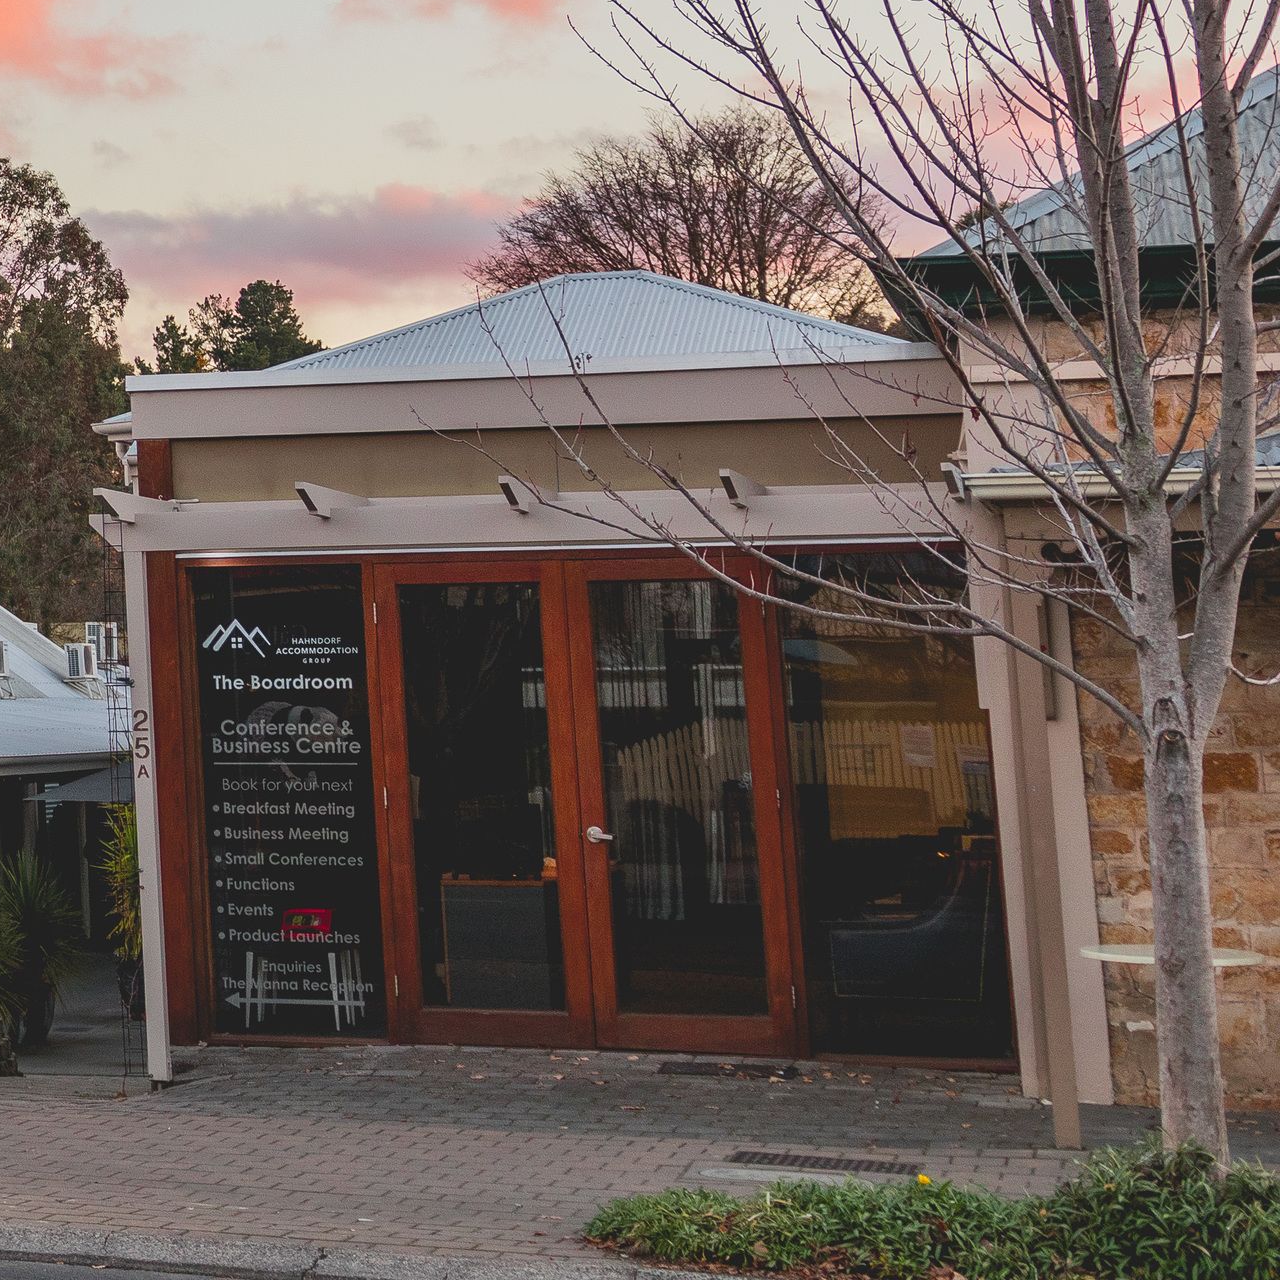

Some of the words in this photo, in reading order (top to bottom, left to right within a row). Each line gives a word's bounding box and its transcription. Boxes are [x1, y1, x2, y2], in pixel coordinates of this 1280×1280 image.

[292, 637, 341, 645] HAHNDORF
[276, 647, 358, 655] ACCOMMODATION
[213, 675, 244, 690] The
[251, 674, 353, 690] Boardroom
[221, 720, 335, 736] Conference
[341, 721, 353, 735] &
[212, 738, 290, 754] Business
[296, 738, 361, 754] Centre
[222, 778, 258, 791] Book
[262, 778, 281, 791] for
[285, 782, 318, 794] your
[321, 779, 353, 792] next
[223, 802, 290, 815] Breakfast
[295, 802, 355, 818] Meeting
[224, 827, 284, 840] Business
[289, 827, 349, 843] Meeting
[225, 852, 265, 865] Small
[269, 853, 364, 867] Conferences
[227, 878, 295, 891] Functions
[228, 904, 274, 917] Events
[229, 929, 285, 942] Product
[290, 931, 361, 944] Launches
[261, 960, 322, 974] Enquiries
[222, 977, 246, 989] The
[303, 979, 374, 994] Reception
